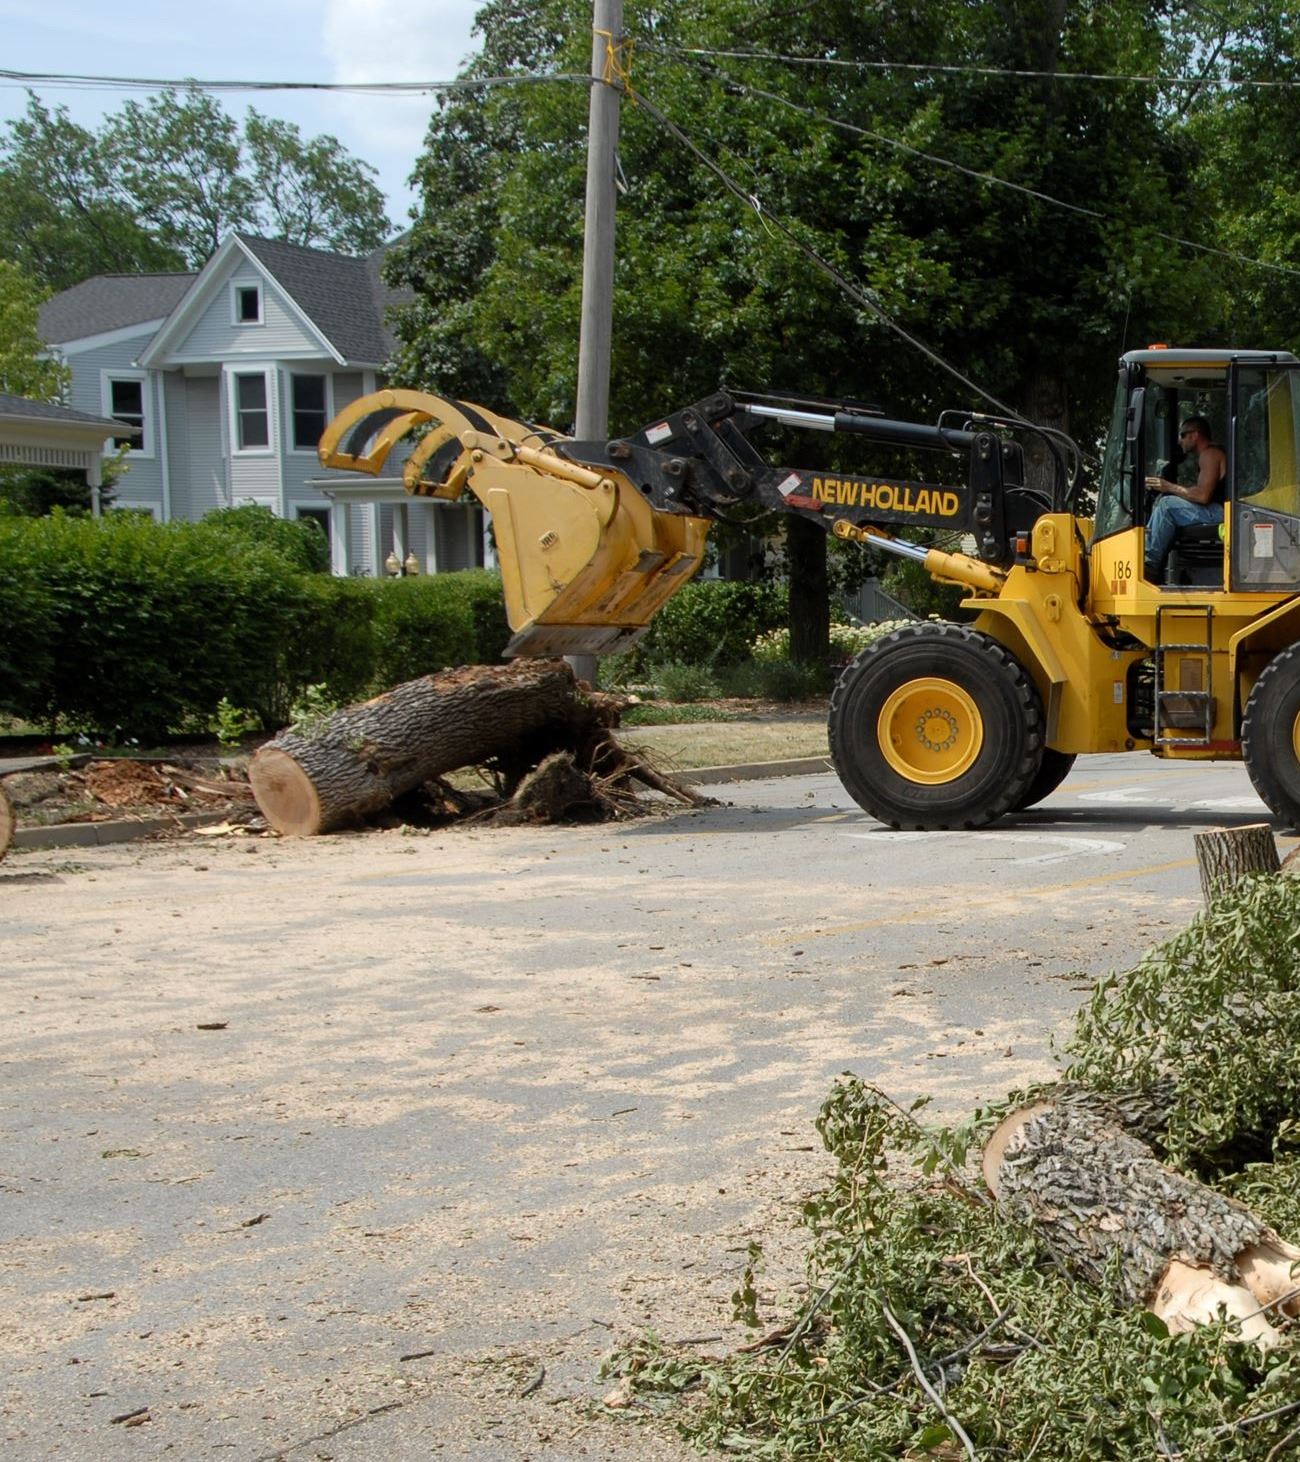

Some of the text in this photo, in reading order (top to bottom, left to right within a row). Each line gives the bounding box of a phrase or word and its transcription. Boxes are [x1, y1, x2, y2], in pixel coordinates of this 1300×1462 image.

[812, 478, 959, 516] NEW HOLLAND
[1113, 560, 1132, 580] 186
